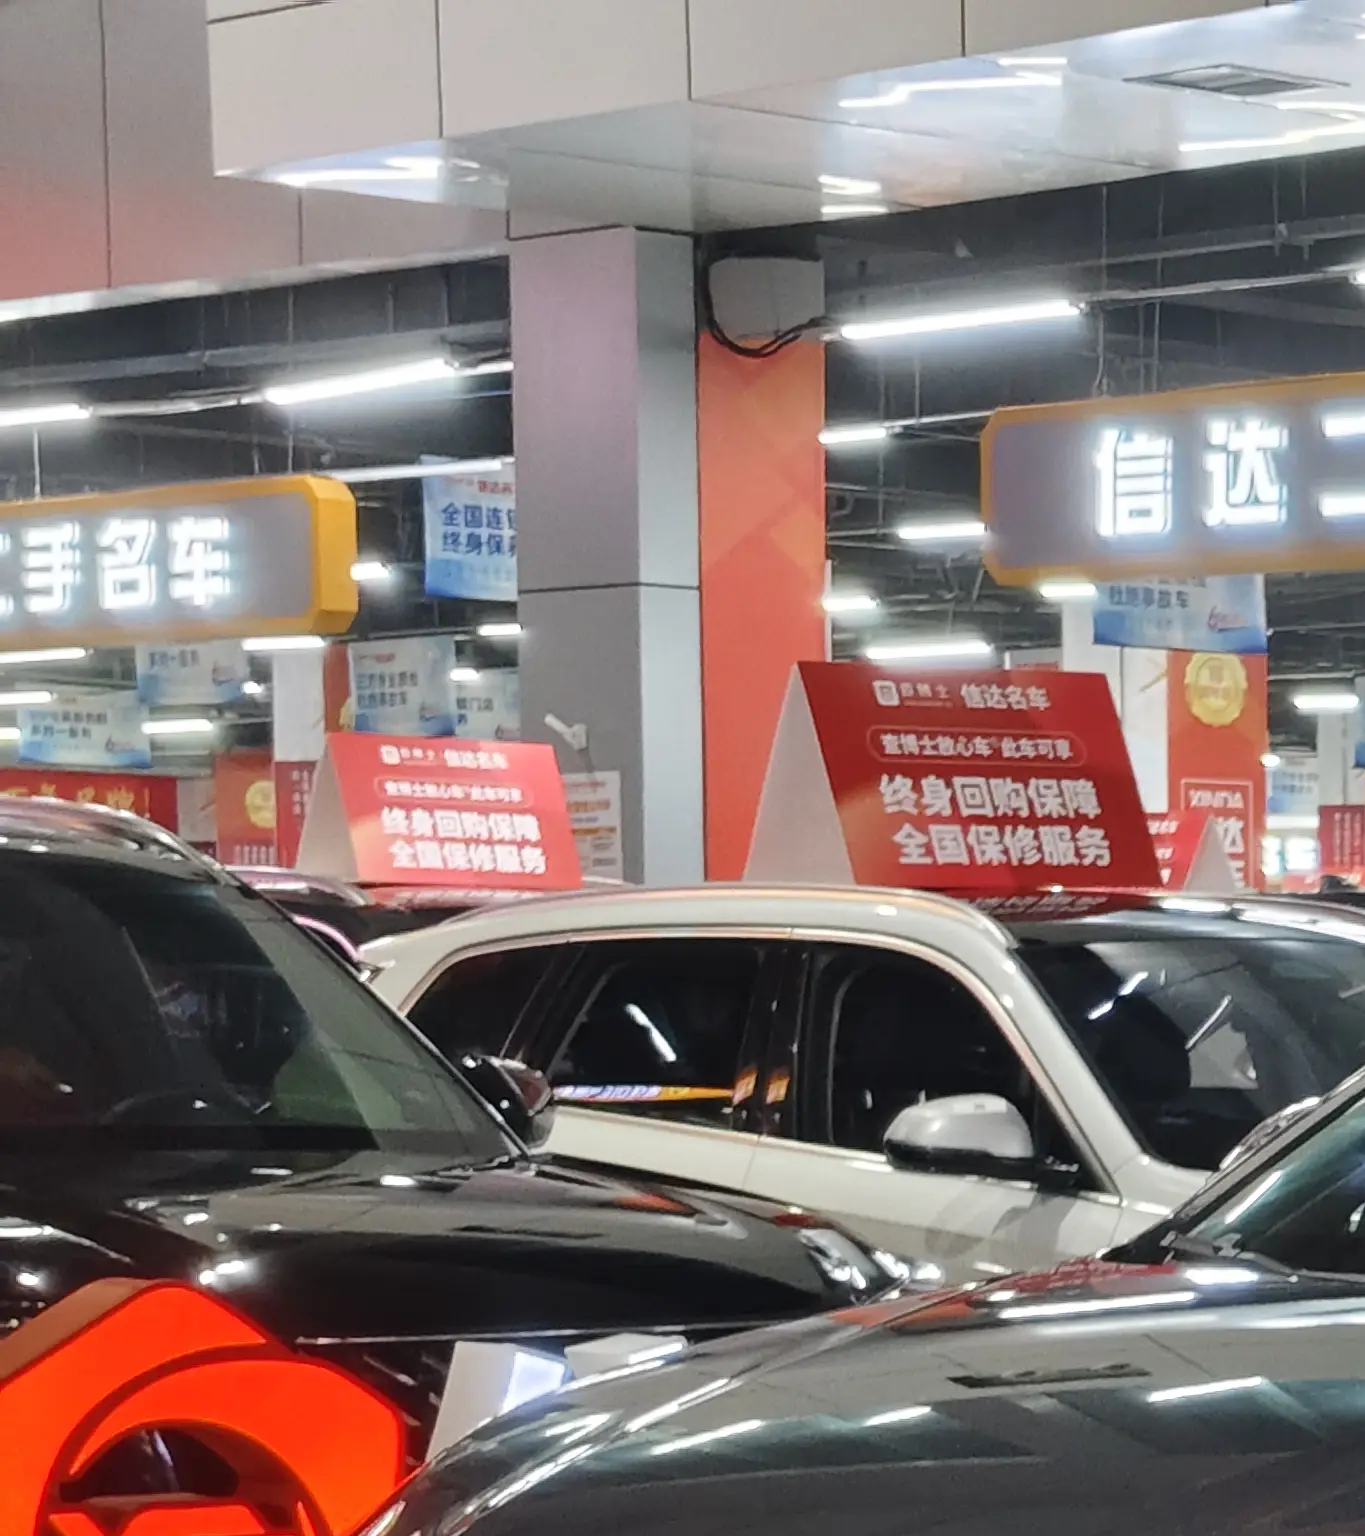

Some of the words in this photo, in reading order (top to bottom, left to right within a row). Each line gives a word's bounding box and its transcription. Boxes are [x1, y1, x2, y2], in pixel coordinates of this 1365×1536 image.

[0, 516, 230, 616] 手名车
[879, 773, 1102, 819] 终身回购保障
[380, 805, 542, 843] 终身回购保障
[892, 821, 1112, 867] 全国保修服务
